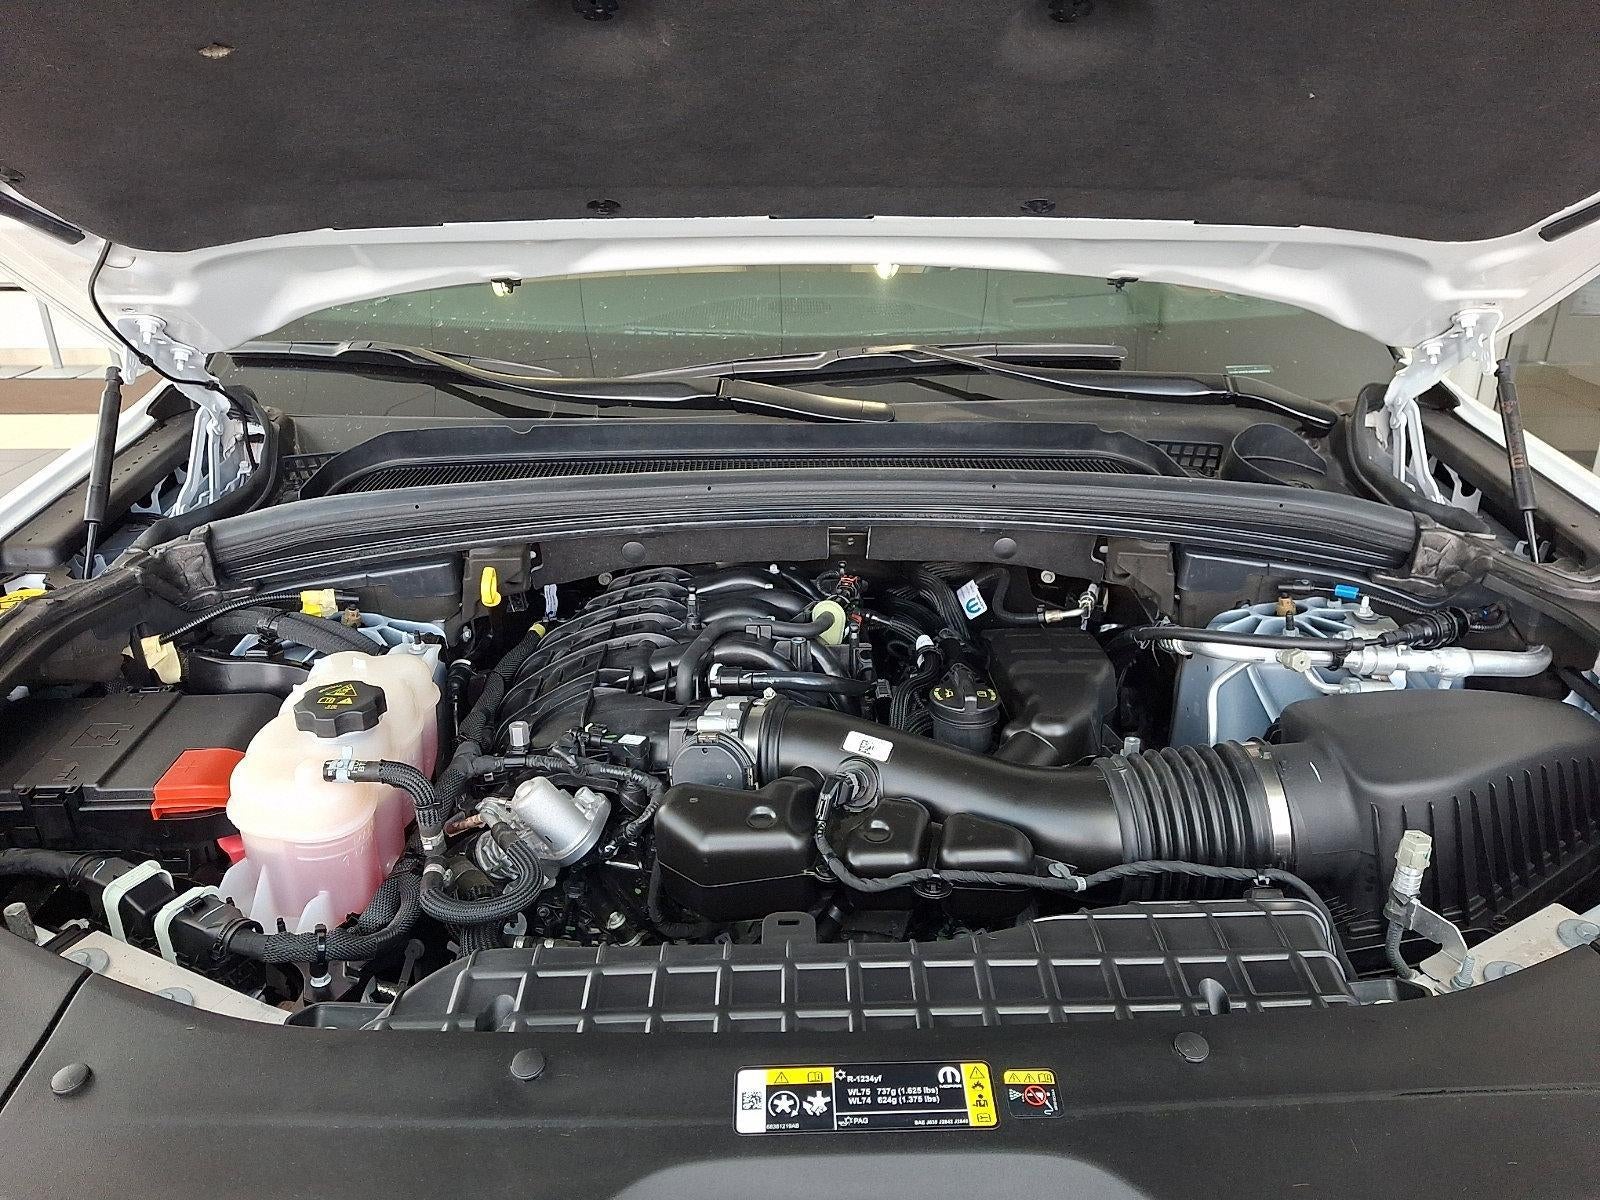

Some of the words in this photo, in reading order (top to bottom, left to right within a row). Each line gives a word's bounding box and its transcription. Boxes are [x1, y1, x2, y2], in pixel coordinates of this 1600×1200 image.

[846, 1074, 882, 1084] R-1234yf
[876, 1087, 897, 1096] 737g
[923, 1086, 939, 1095] lbs)
[848, 1097, 872, 1105] WL74
[877, 1096, 898, 1105] 624g
[924, 1095, 940, 1104] lbs)
[853, 1117, 869, 1125] PAG
